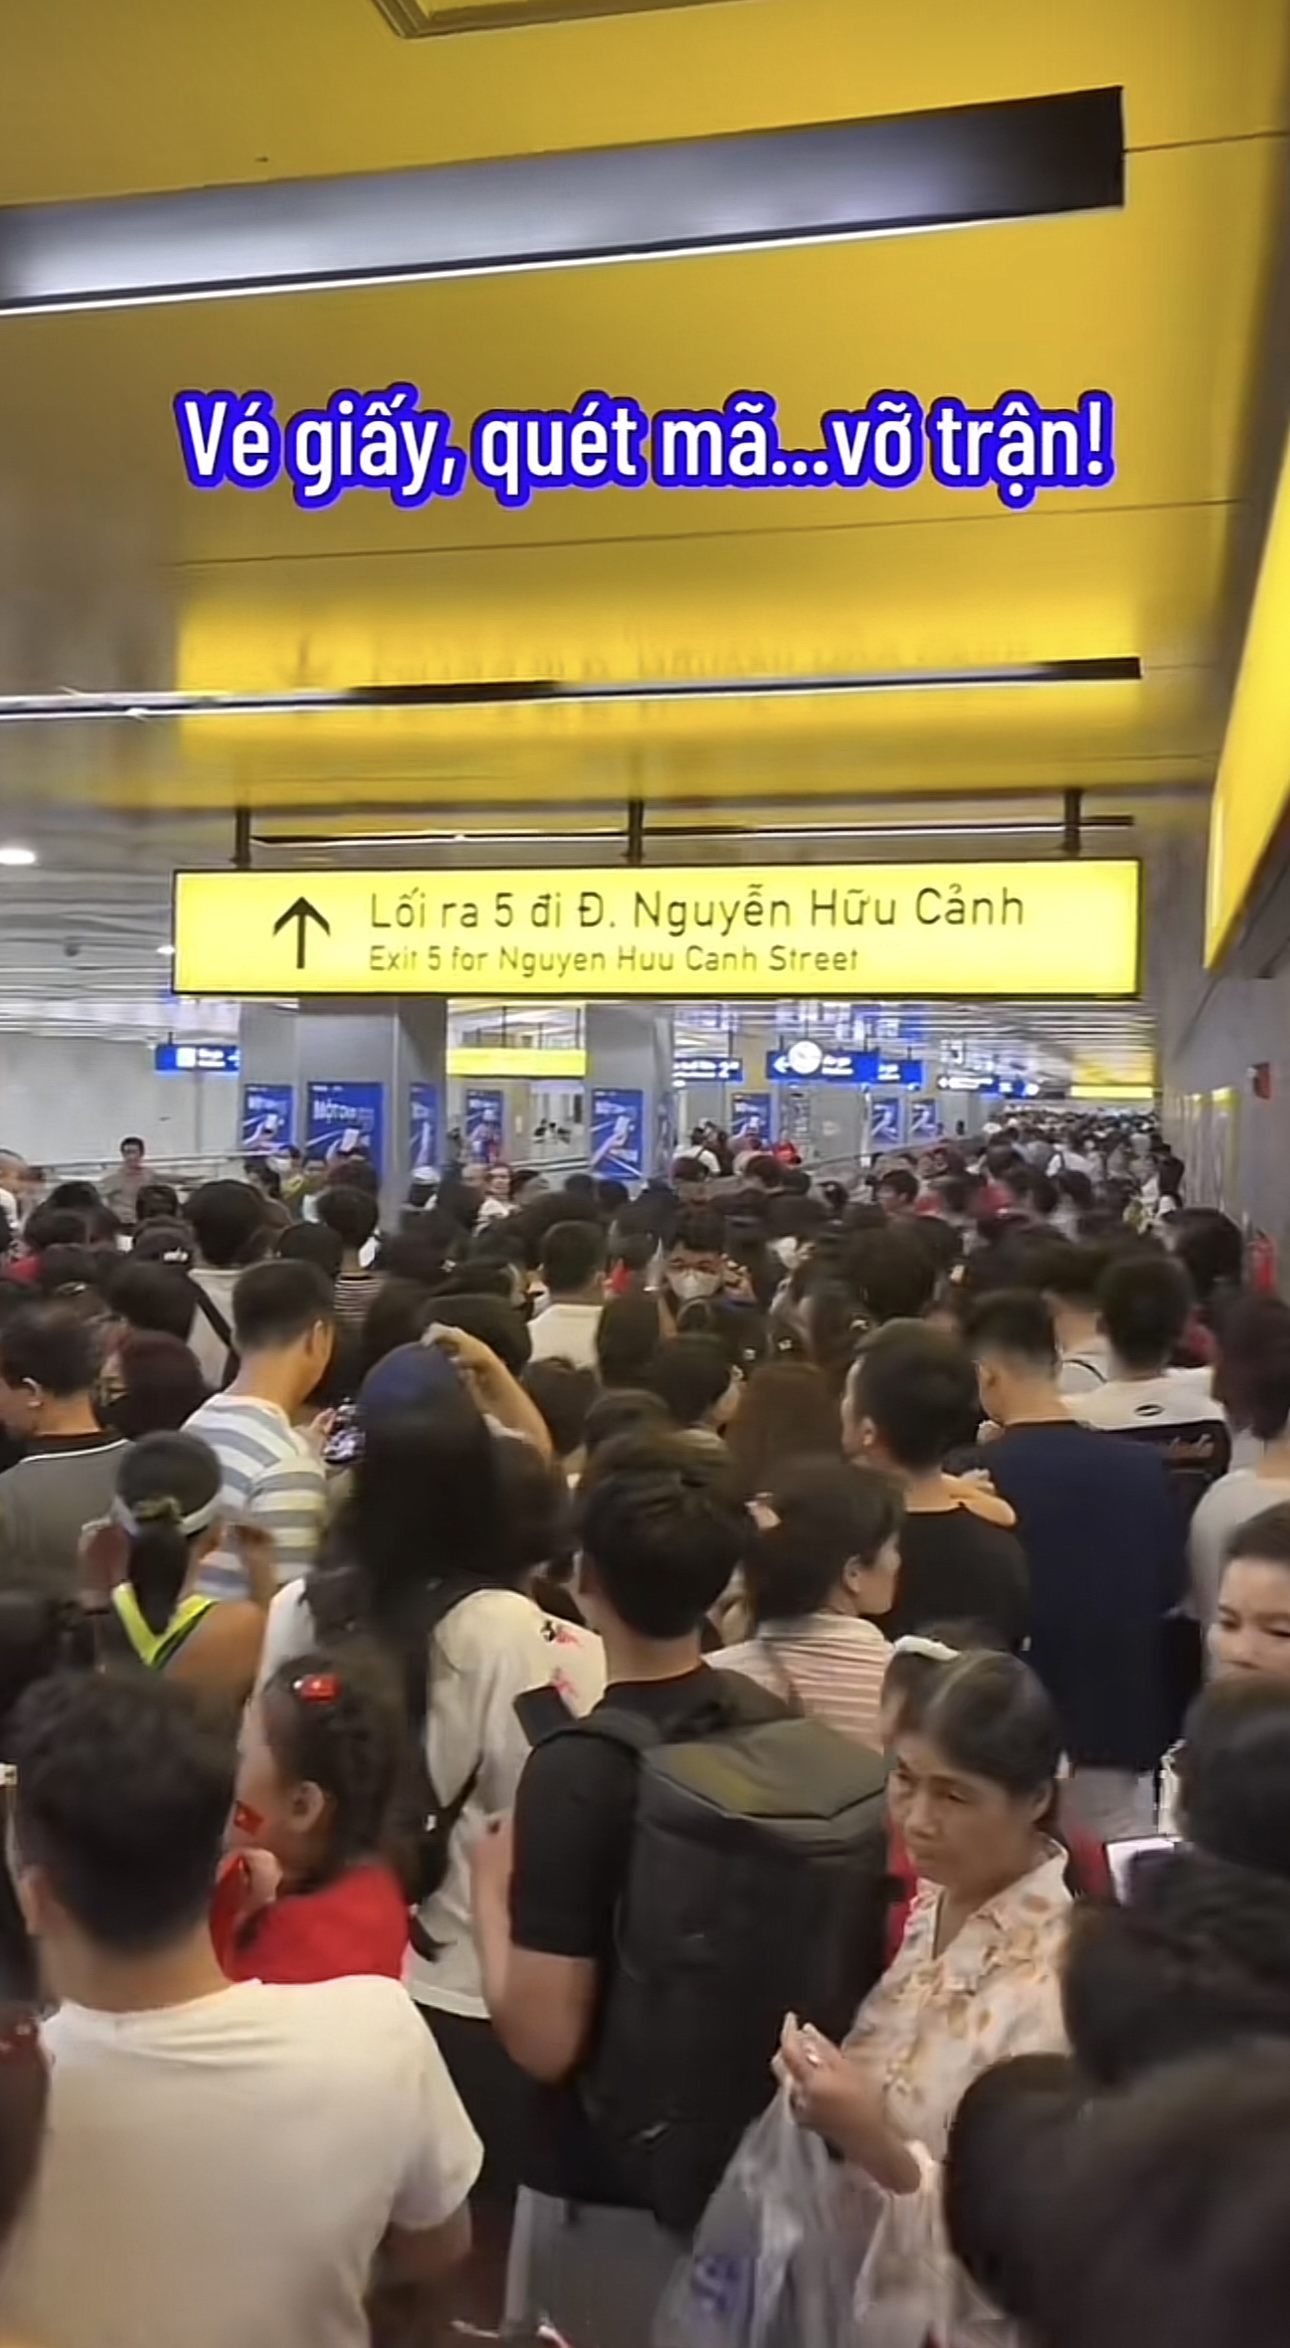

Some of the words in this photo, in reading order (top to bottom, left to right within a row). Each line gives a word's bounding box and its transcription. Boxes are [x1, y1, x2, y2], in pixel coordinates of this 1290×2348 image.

[371, 886, 426, 929] Lối
[441, 902, 479, 929] ra
[494, 891, 514, 929] 5
[530, 891, 562, 929] đi
[577, 890, 616, 929] Đ.
[634, 883, 791, 937] Nguyễn
[810, 887, 896, 927] Hữu
[915, 882, 1024, 926] Cảnh
[370, 944, 418, 972] Exit
[428, 944, 442, 971] 5
[452, 944, 489, 972] for
[499, 946, 607, 979] Nguyen
[617, 945, 674, 972] Huu
[686, 944, 758, 972] Canh
[768, 944, 858, 972] Street
